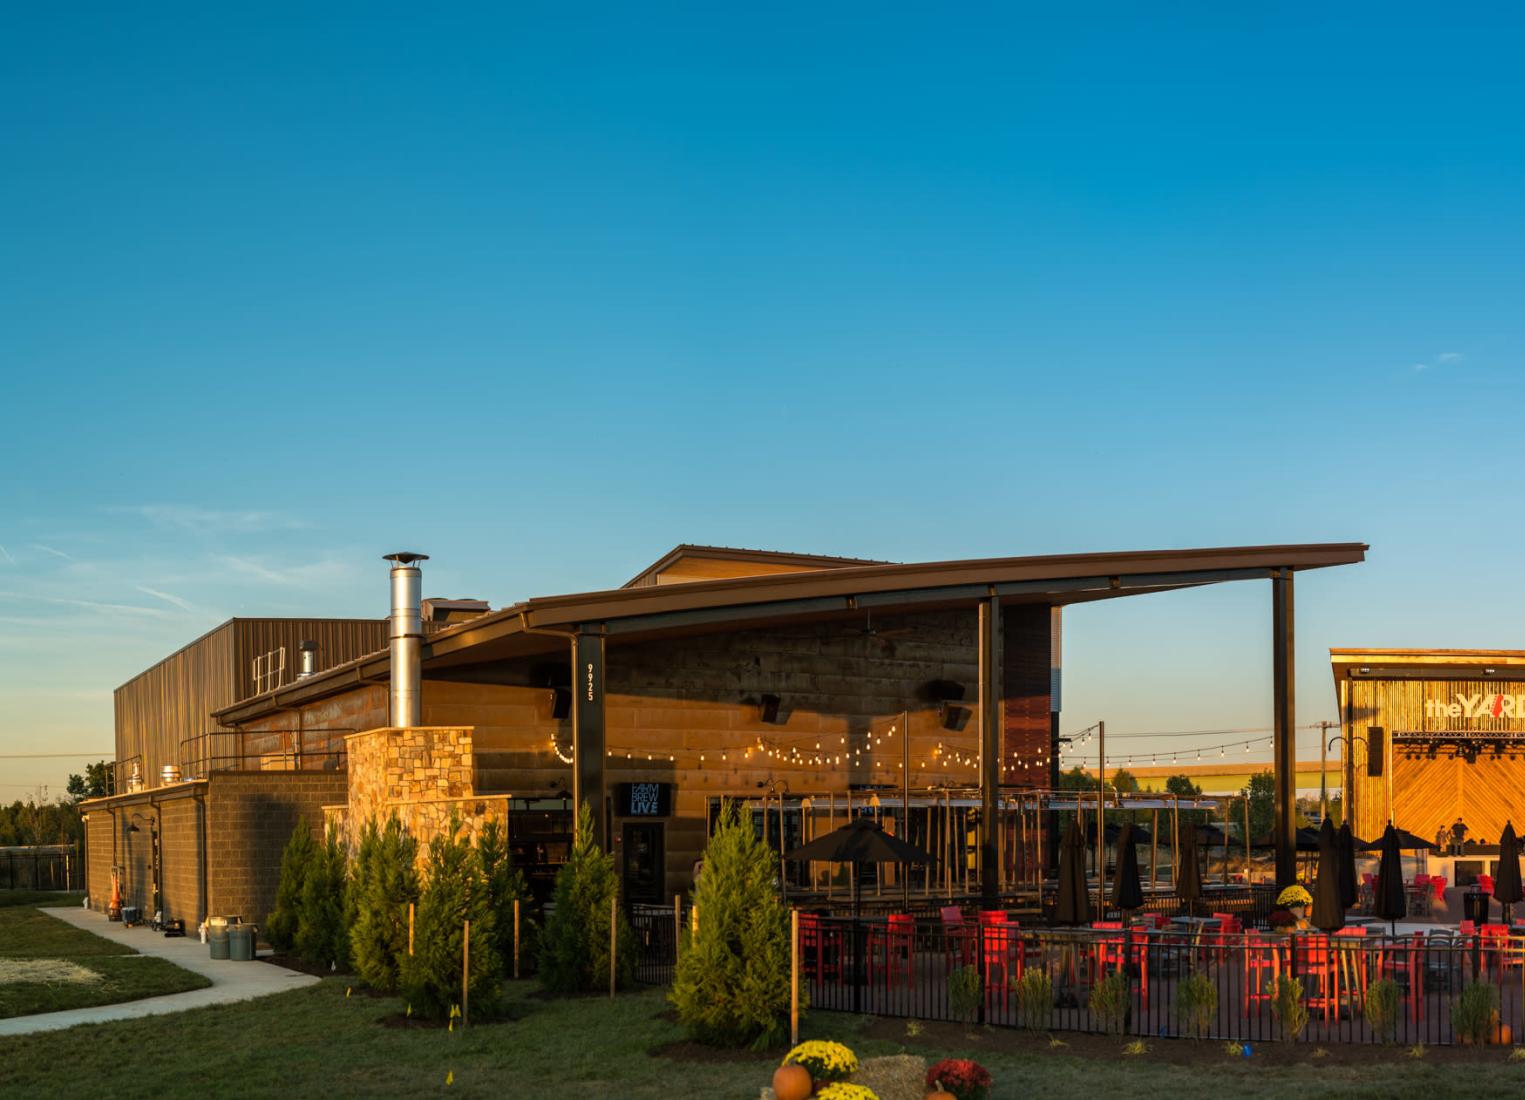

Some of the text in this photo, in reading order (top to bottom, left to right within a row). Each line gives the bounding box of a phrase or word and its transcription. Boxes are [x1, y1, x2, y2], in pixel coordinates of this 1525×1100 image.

[631, 783, 659, 793] FARM
[632, 792, 659, 801] BREW
[631, 801, 658, 815] LIVE
